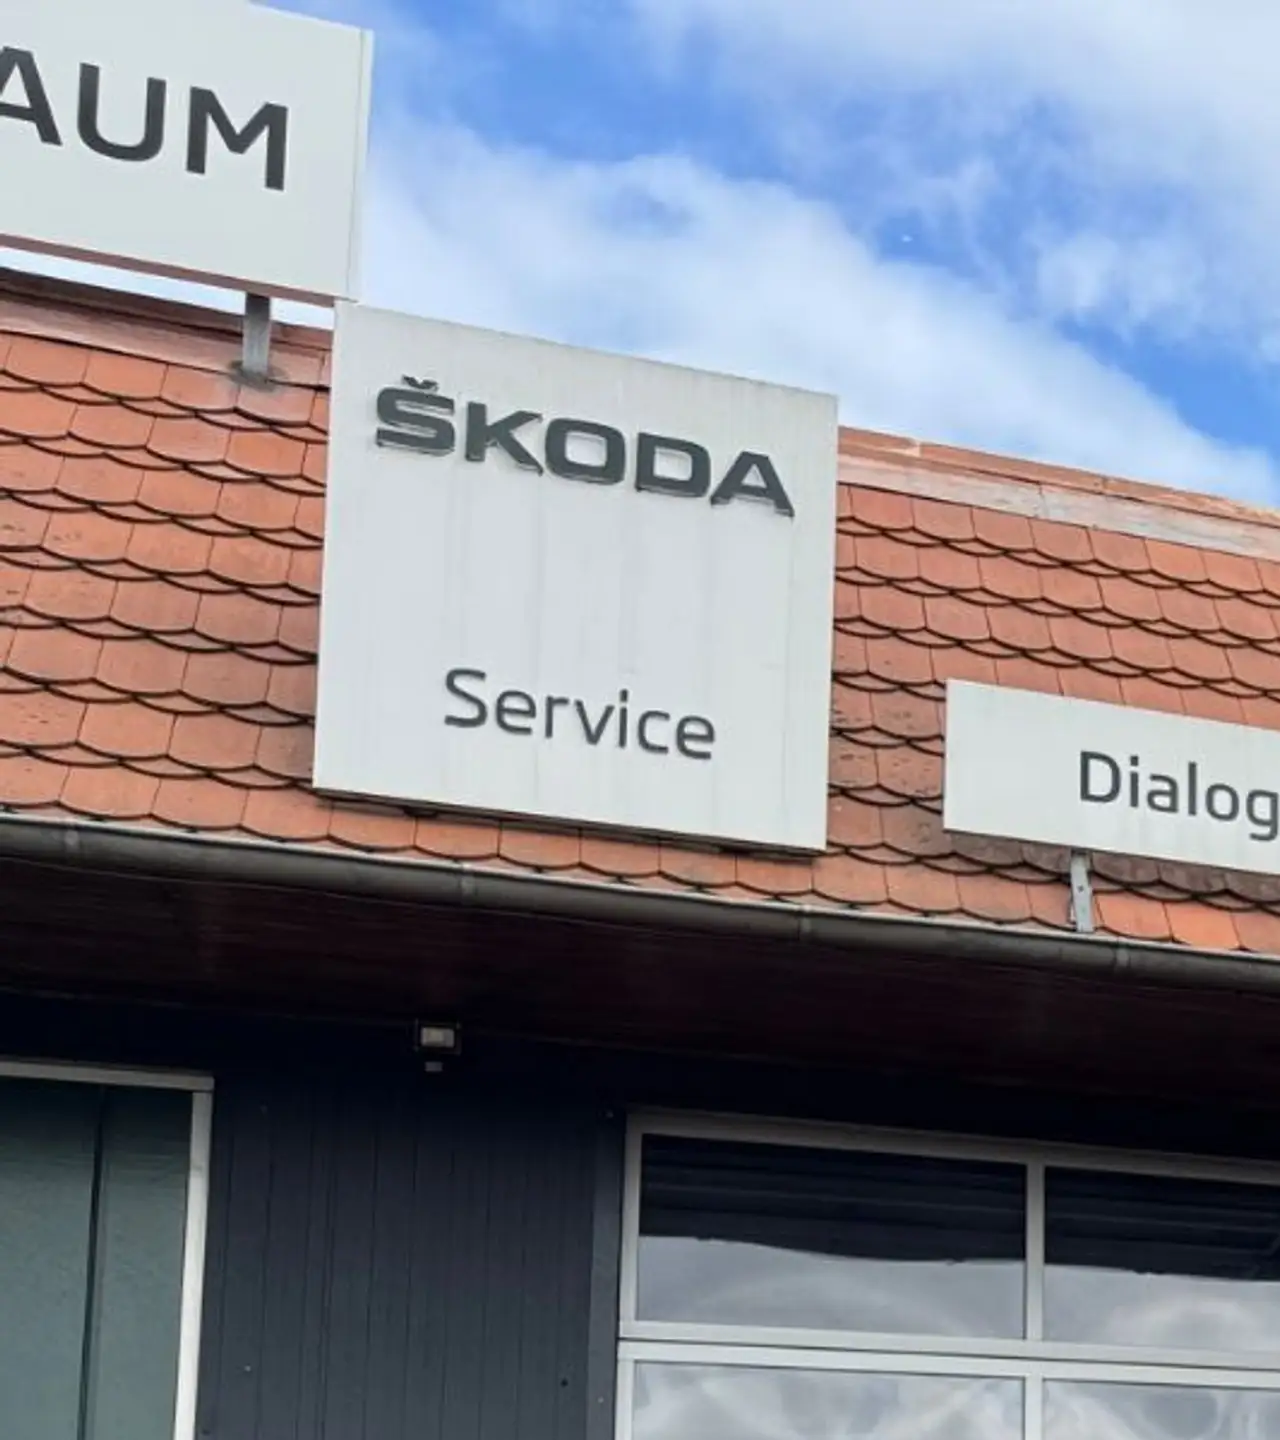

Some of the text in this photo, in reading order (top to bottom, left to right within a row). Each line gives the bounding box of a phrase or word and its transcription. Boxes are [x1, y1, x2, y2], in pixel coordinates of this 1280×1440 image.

[0, 45, 289, 191] AUM
[375, 376, 796, 518] ŠKODA
[443, 668, 717, 761] Service
